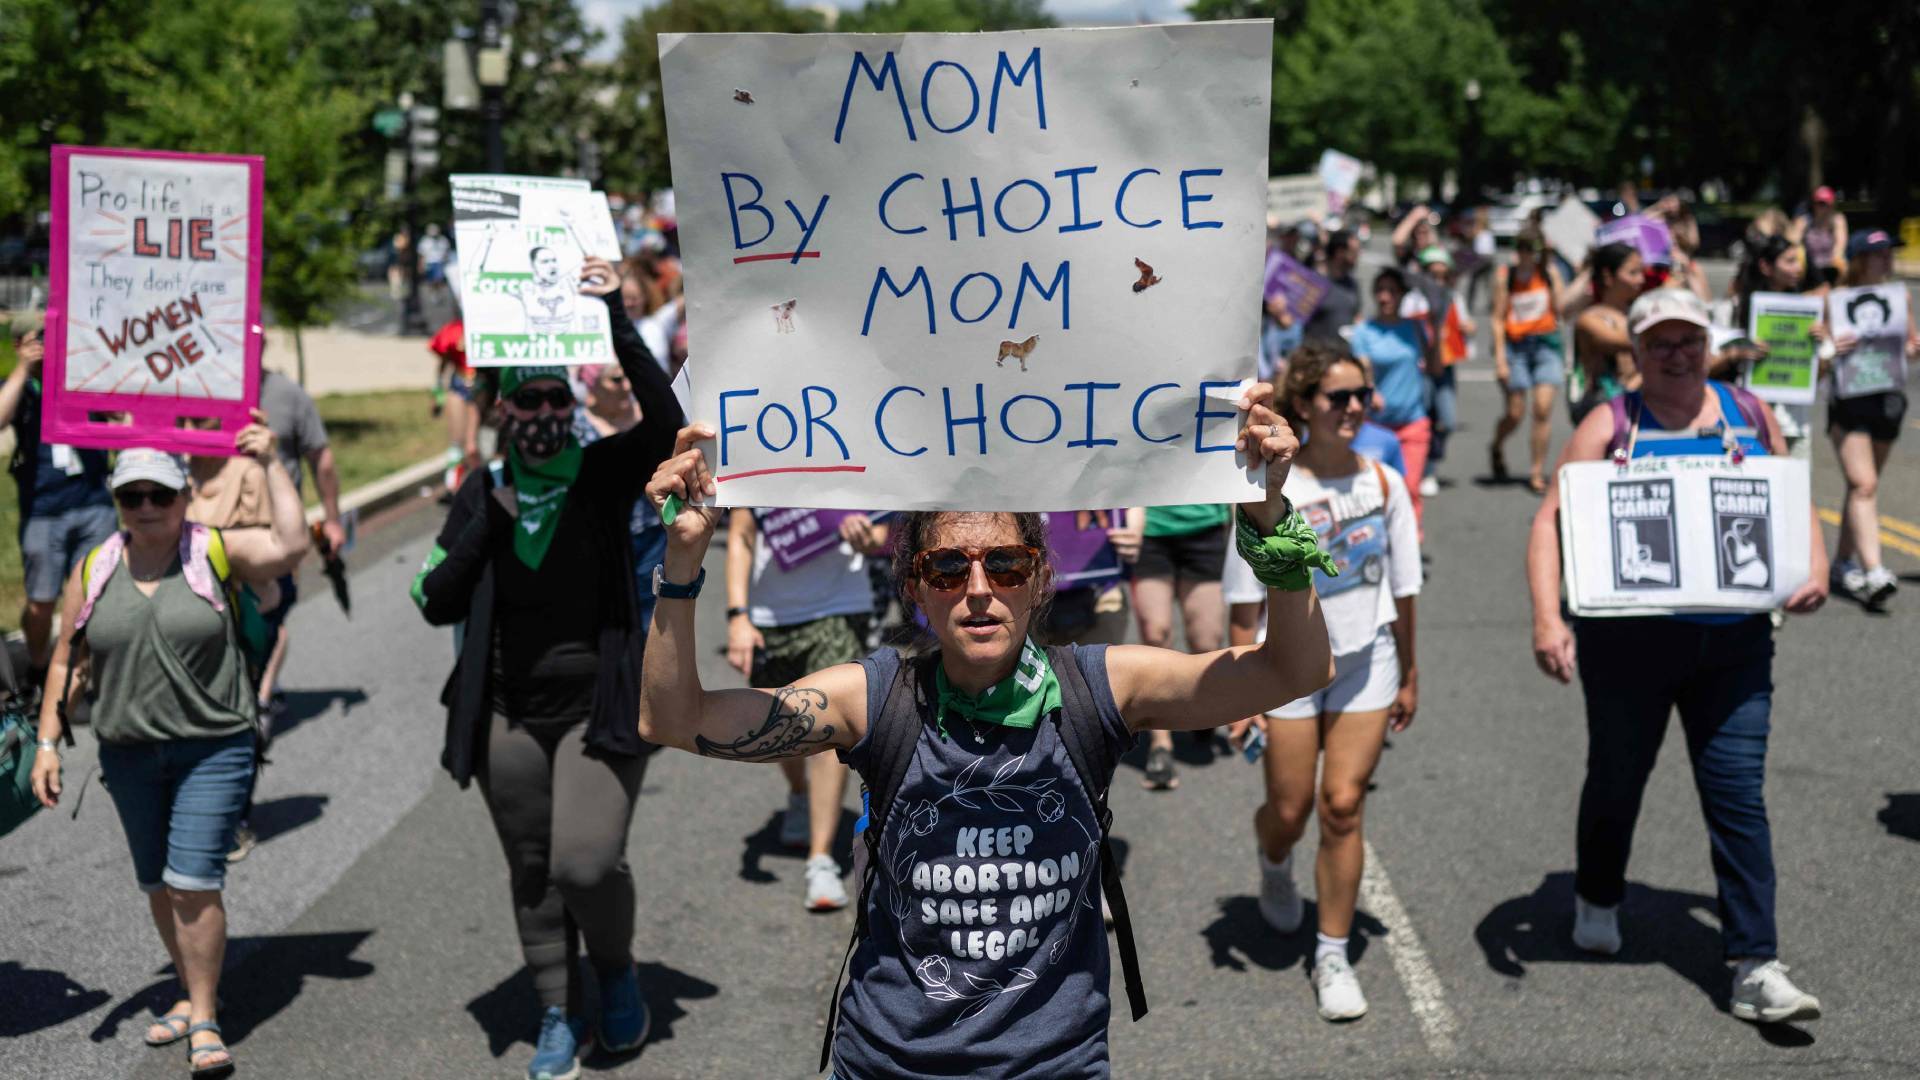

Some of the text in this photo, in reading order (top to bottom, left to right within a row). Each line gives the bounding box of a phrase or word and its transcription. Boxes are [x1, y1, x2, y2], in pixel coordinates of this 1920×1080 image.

[834, 47, 1047, 143] MOM
[721, 166, 1223, 265] By CHOICE
[133, 217, 216, 261] LIE
[87, 261, 133, 297] They
[190, 280, 226, 295] care
[89, 296, 104, 319] if
[861, 261, 1069, 336] MOM
[96, 291, 204, 358] WOMEN
[473, 334, 608, 359] is with us
[719, 380, 1244, 467] FOR CHOICE
[1611, 483, 1671, 500] FREE TO
[1612, 499, 1671, 518] CARRY
[1714, 494, 1769, 515] CARRY
[770, 529, 797, 551] For
[955, 824, 1034, 858] KEEP
[912, 851, 1080, 894] ABORTION
[920, 888, 1071, 926] SAFE AND
[950, 926, 1040, 961] LEGAL
